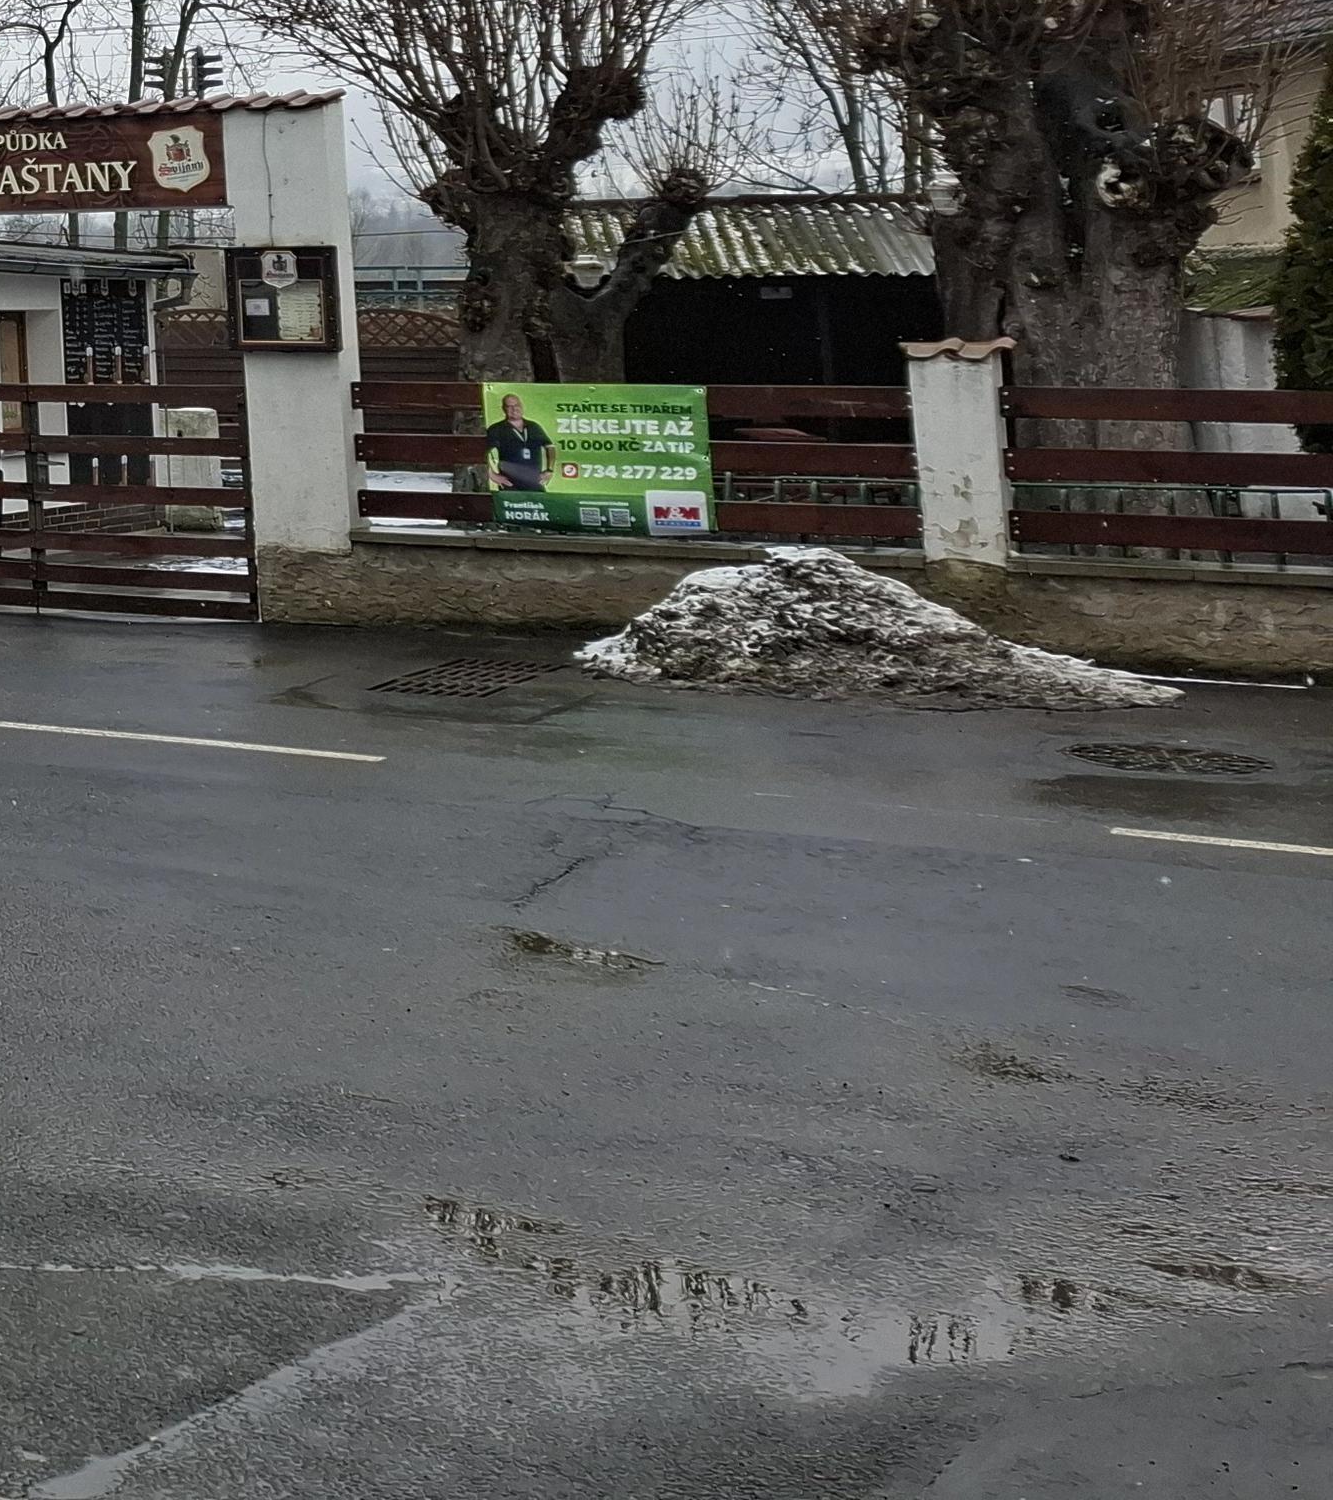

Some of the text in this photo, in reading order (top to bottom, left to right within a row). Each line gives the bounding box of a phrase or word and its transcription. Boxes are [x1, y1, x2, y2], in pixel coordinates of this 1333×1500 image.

[556, 400, 692, 415] STAŇTE SE TIPAŘEM
[557, 416, 694, 436] ZÍSKEJTE AŽ
[559, 437, 695, 453] 10 000 KČ ZA TIP
[581, 465, 697, 480] 734 277 229
